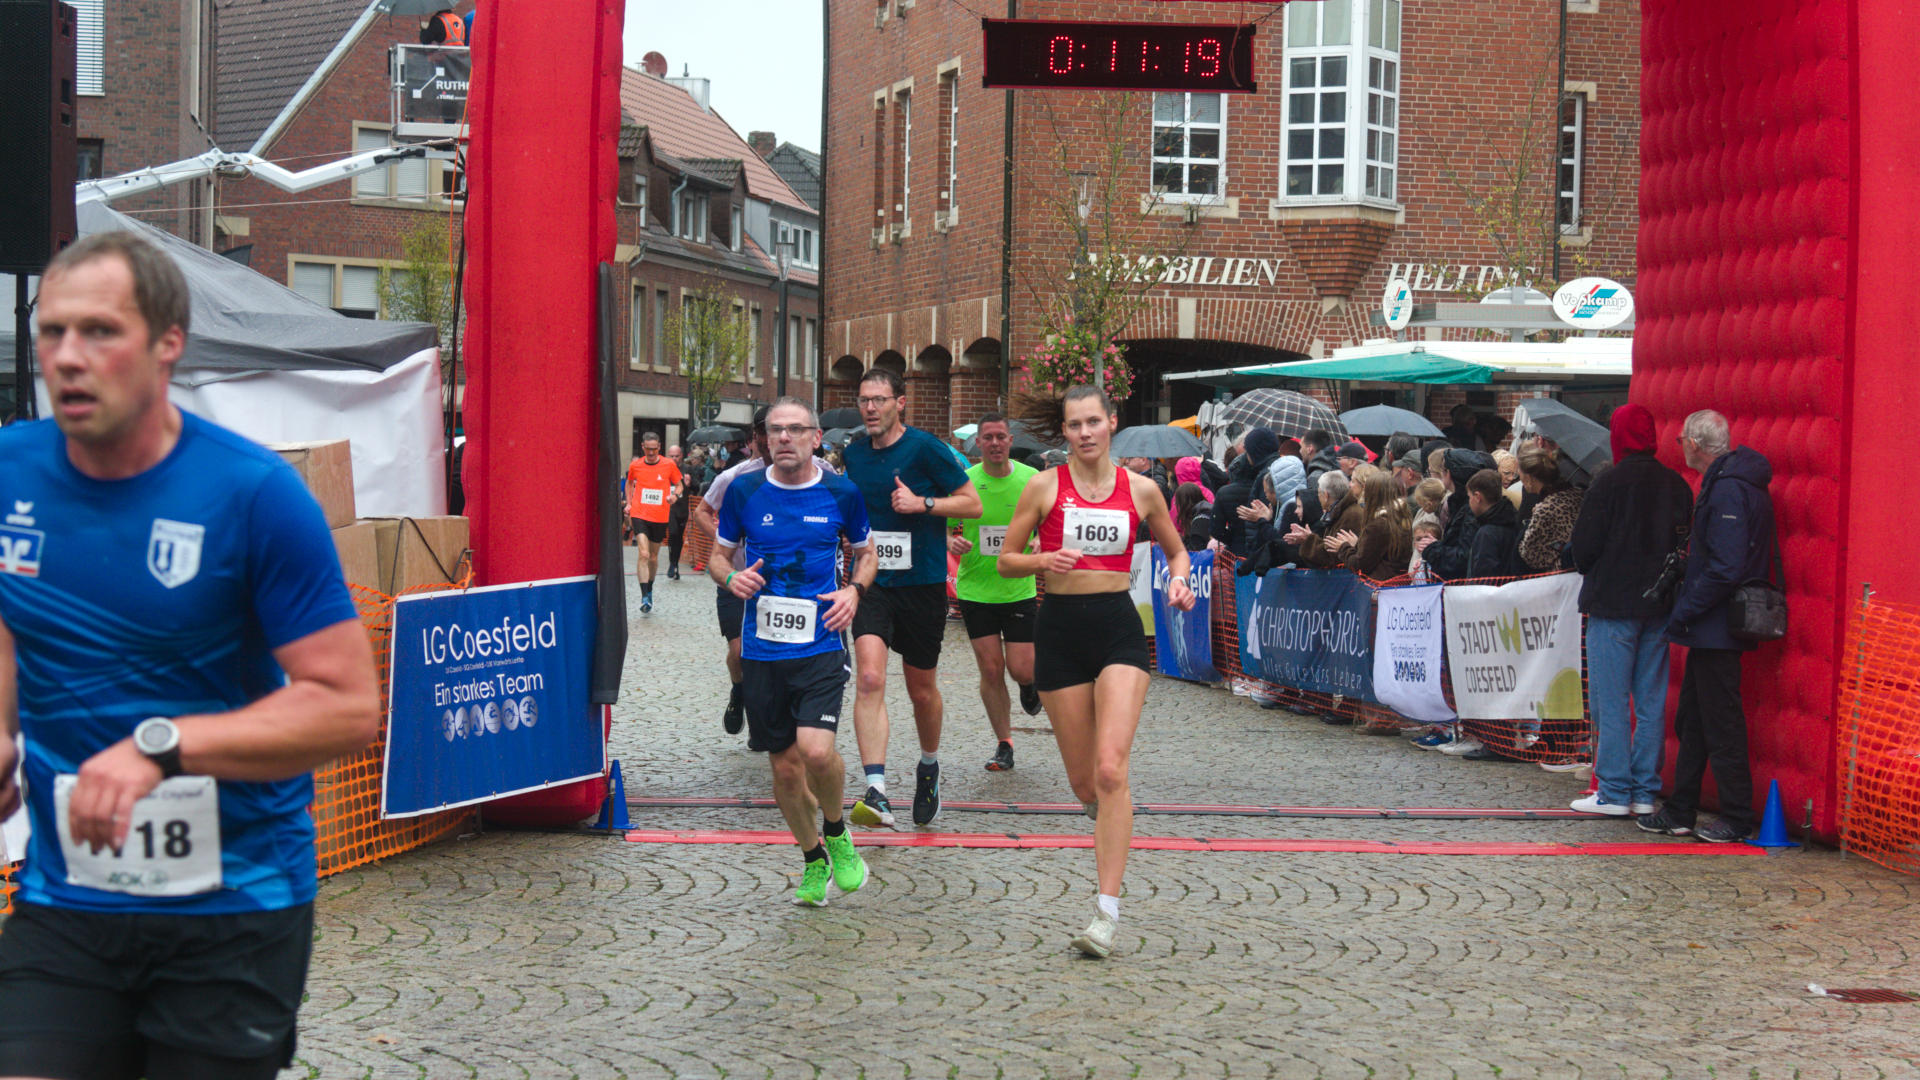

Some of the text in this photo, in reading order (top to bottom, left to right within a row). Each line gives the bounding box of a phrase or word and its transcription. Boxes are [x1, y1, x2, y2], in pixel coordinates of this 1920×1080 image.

[1049, 36, 1221, 77] 0:11:19
[436, 80, 469, 91] RUTH
[1561, 292, 1627, 314] Voßkamp
[1075, 524, 1119, 543] 1603
[1161, 564, 1211, 599] Celd
[764, 611, 806, 630] 1599
[1399, 605, 1431, 631] Coesfeld
[423, 611, 557, 666] LG Coesfeld
[435, 672, 544, 707] Ein starkes Team
[1465, 664, 1517, 694] COESFELD
[90, 819, 192, 859] 18
